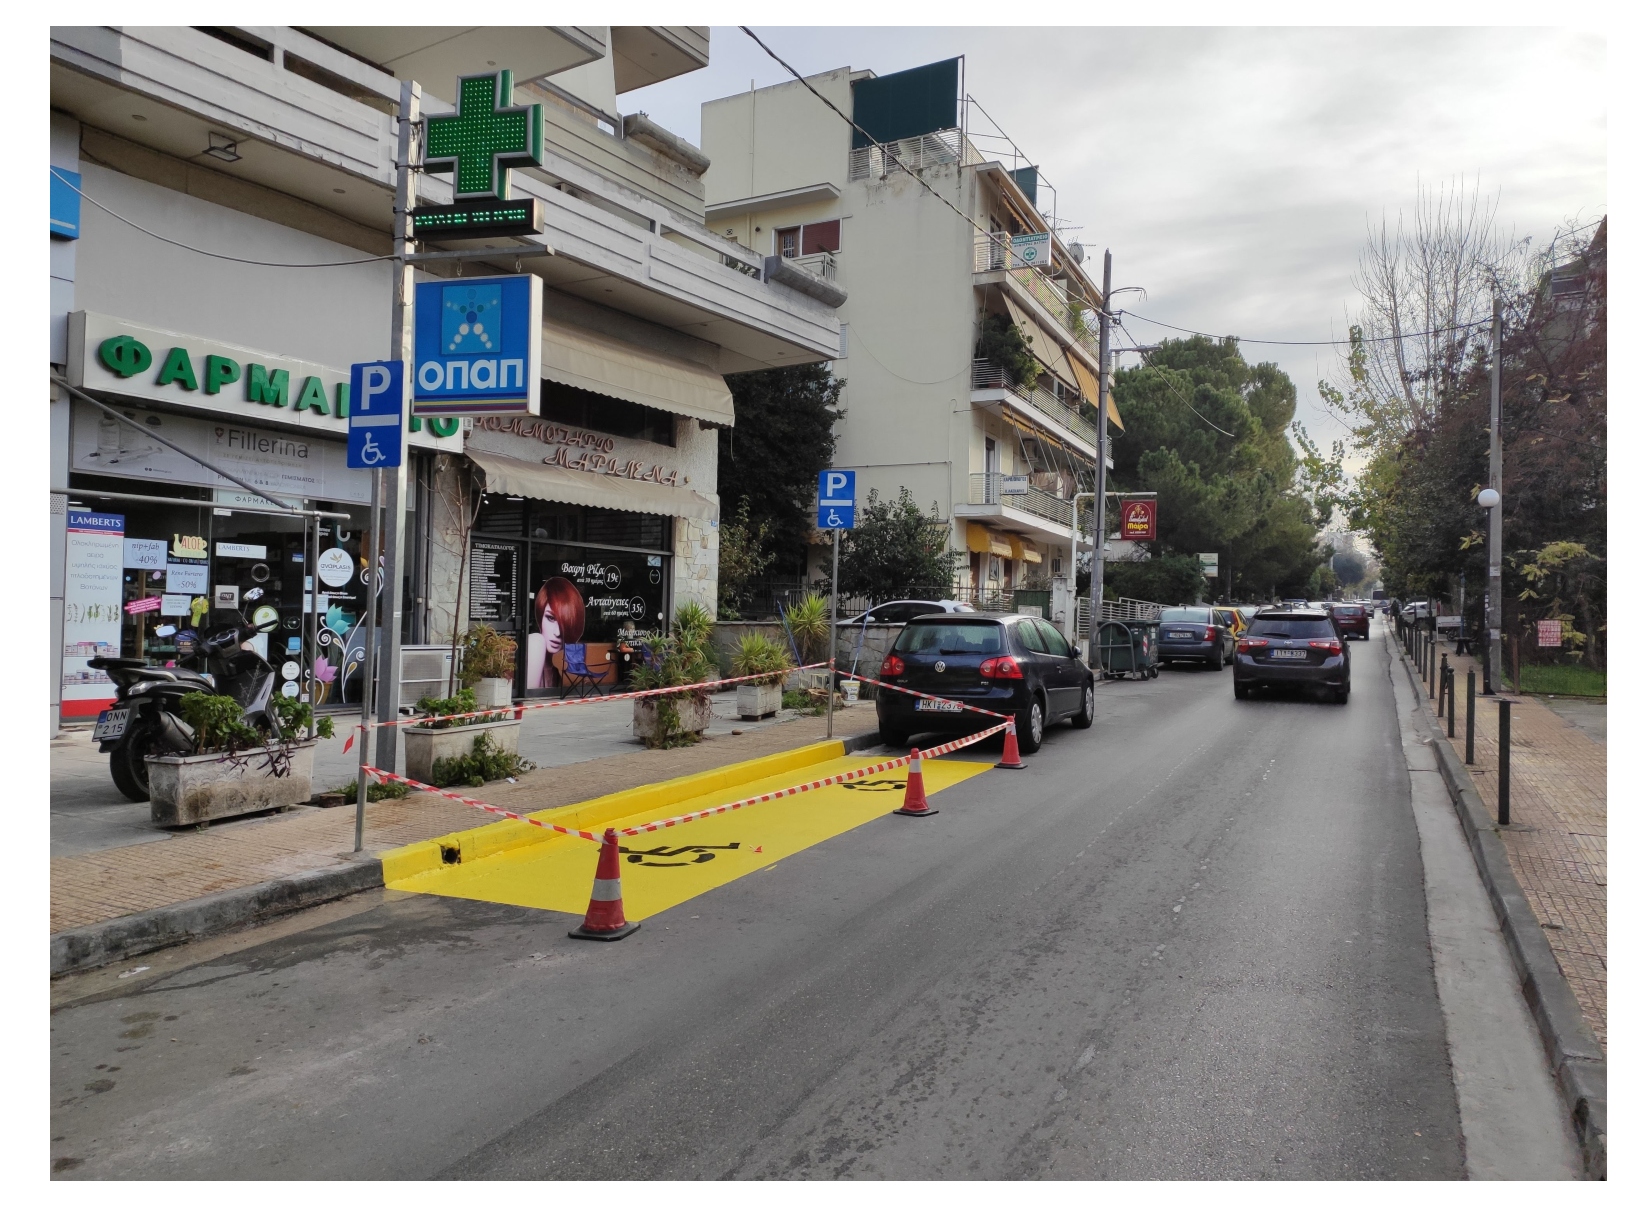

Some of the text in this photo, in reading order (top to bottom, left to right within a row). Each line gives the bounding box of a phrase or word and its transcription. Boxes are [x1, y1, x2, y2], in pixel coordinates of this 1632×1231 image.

[360, 365, 392, 411] P
[228, 428, 309, 459] Fillerina
[544, 448, 679, 487] ΜΑΡΙΛΕΝΑ
[826, 472, 848, 497] P
[70, 515, 122, 528] LAMBERTS
[131, 542, 160, 552] nip+fab
[218, 543, 251, 552] LAMBERTS
[136, 555, 158, 565] -40%
[561, 562, 585, 576] Βαφή
[606, 572, 619, 583] 19€
[177, 581, 197, 589] -50%
[585, 596, 629, 610] Ανταύγειες
[631, 603, 644, 614] 35€
[102, 723, 124, 735] 215
